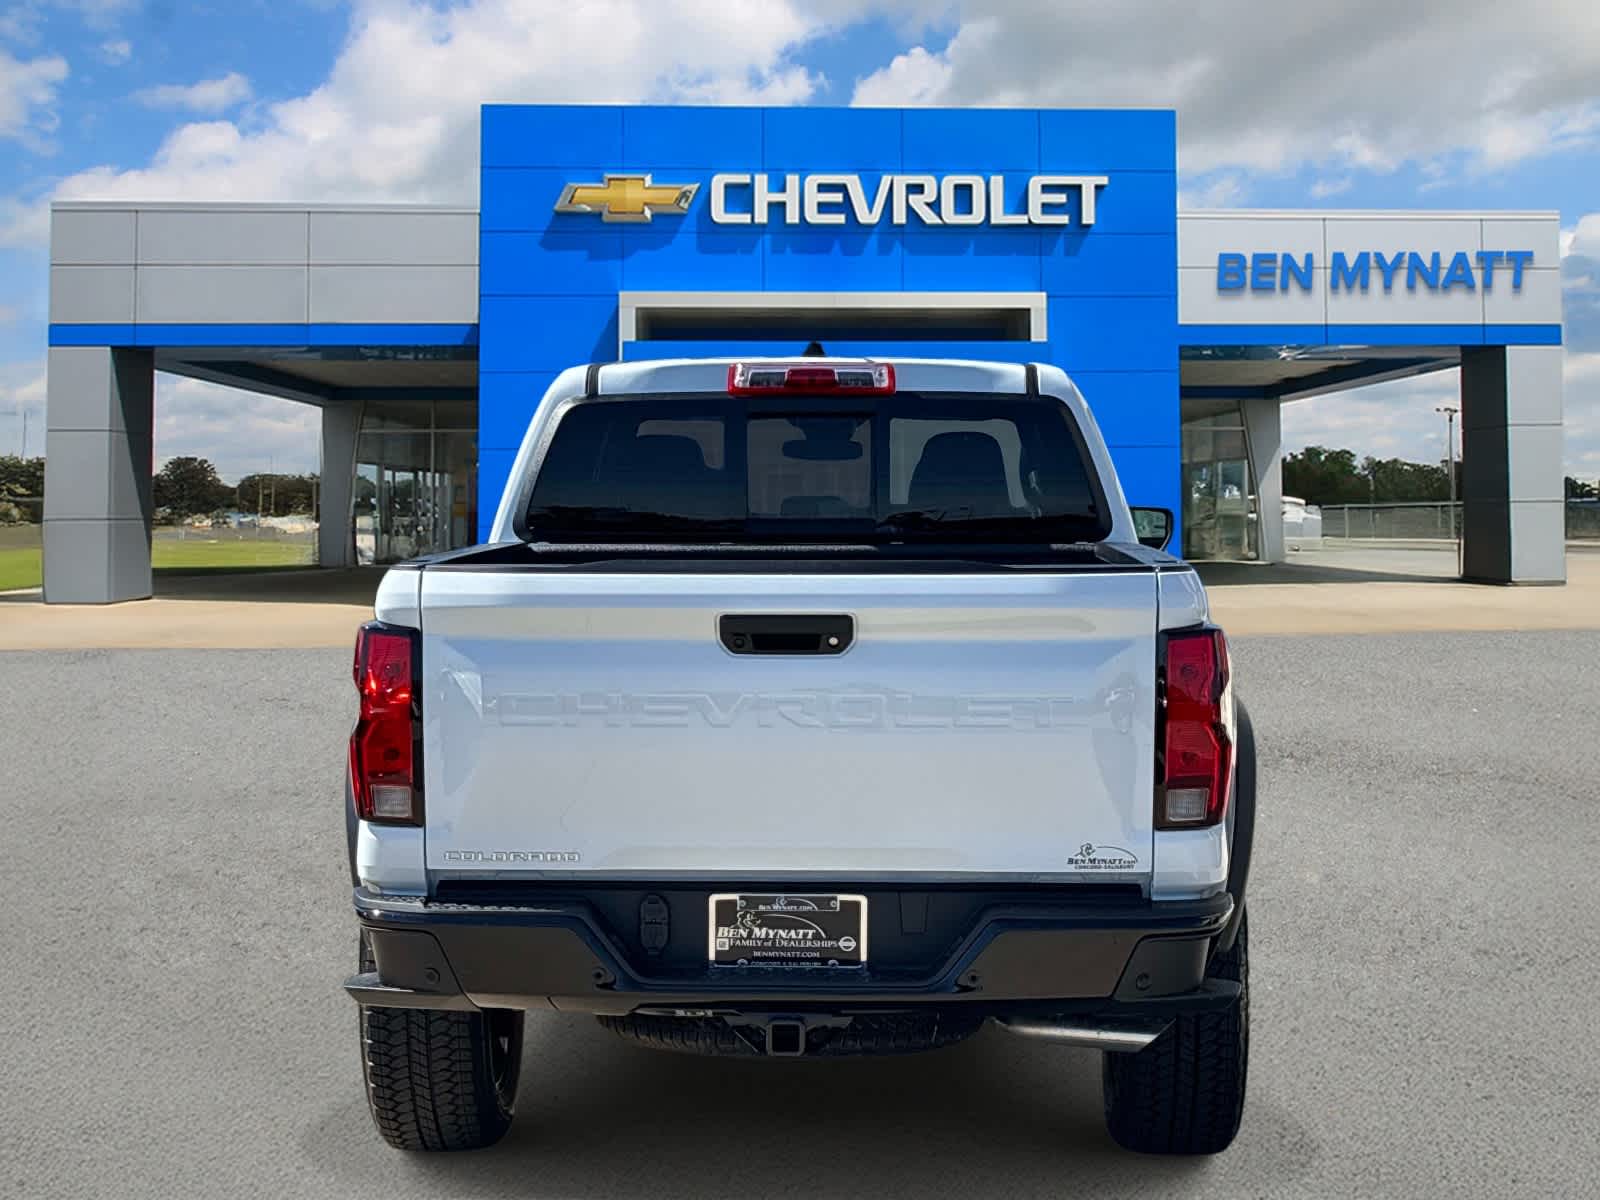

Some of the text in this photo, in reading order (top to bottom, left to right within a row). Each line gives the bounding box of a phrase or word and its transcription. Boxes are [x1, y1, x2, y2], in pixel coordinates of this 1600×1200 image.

[711, 173, 1109, 225] CHEVROLET
[1217, 250, 1534, 291] BEN MYNATT
[499, 691, 1077, 728] CHEVROLET
[444, 851, 581, 862] COLORADO
[716, 927, 816, 938] BEN MYNATT
[730, 938, 763, 948] FAMILY
[763, 940, 772, 948] of
[775, 939, 838, 948] DEALERSHIPS
